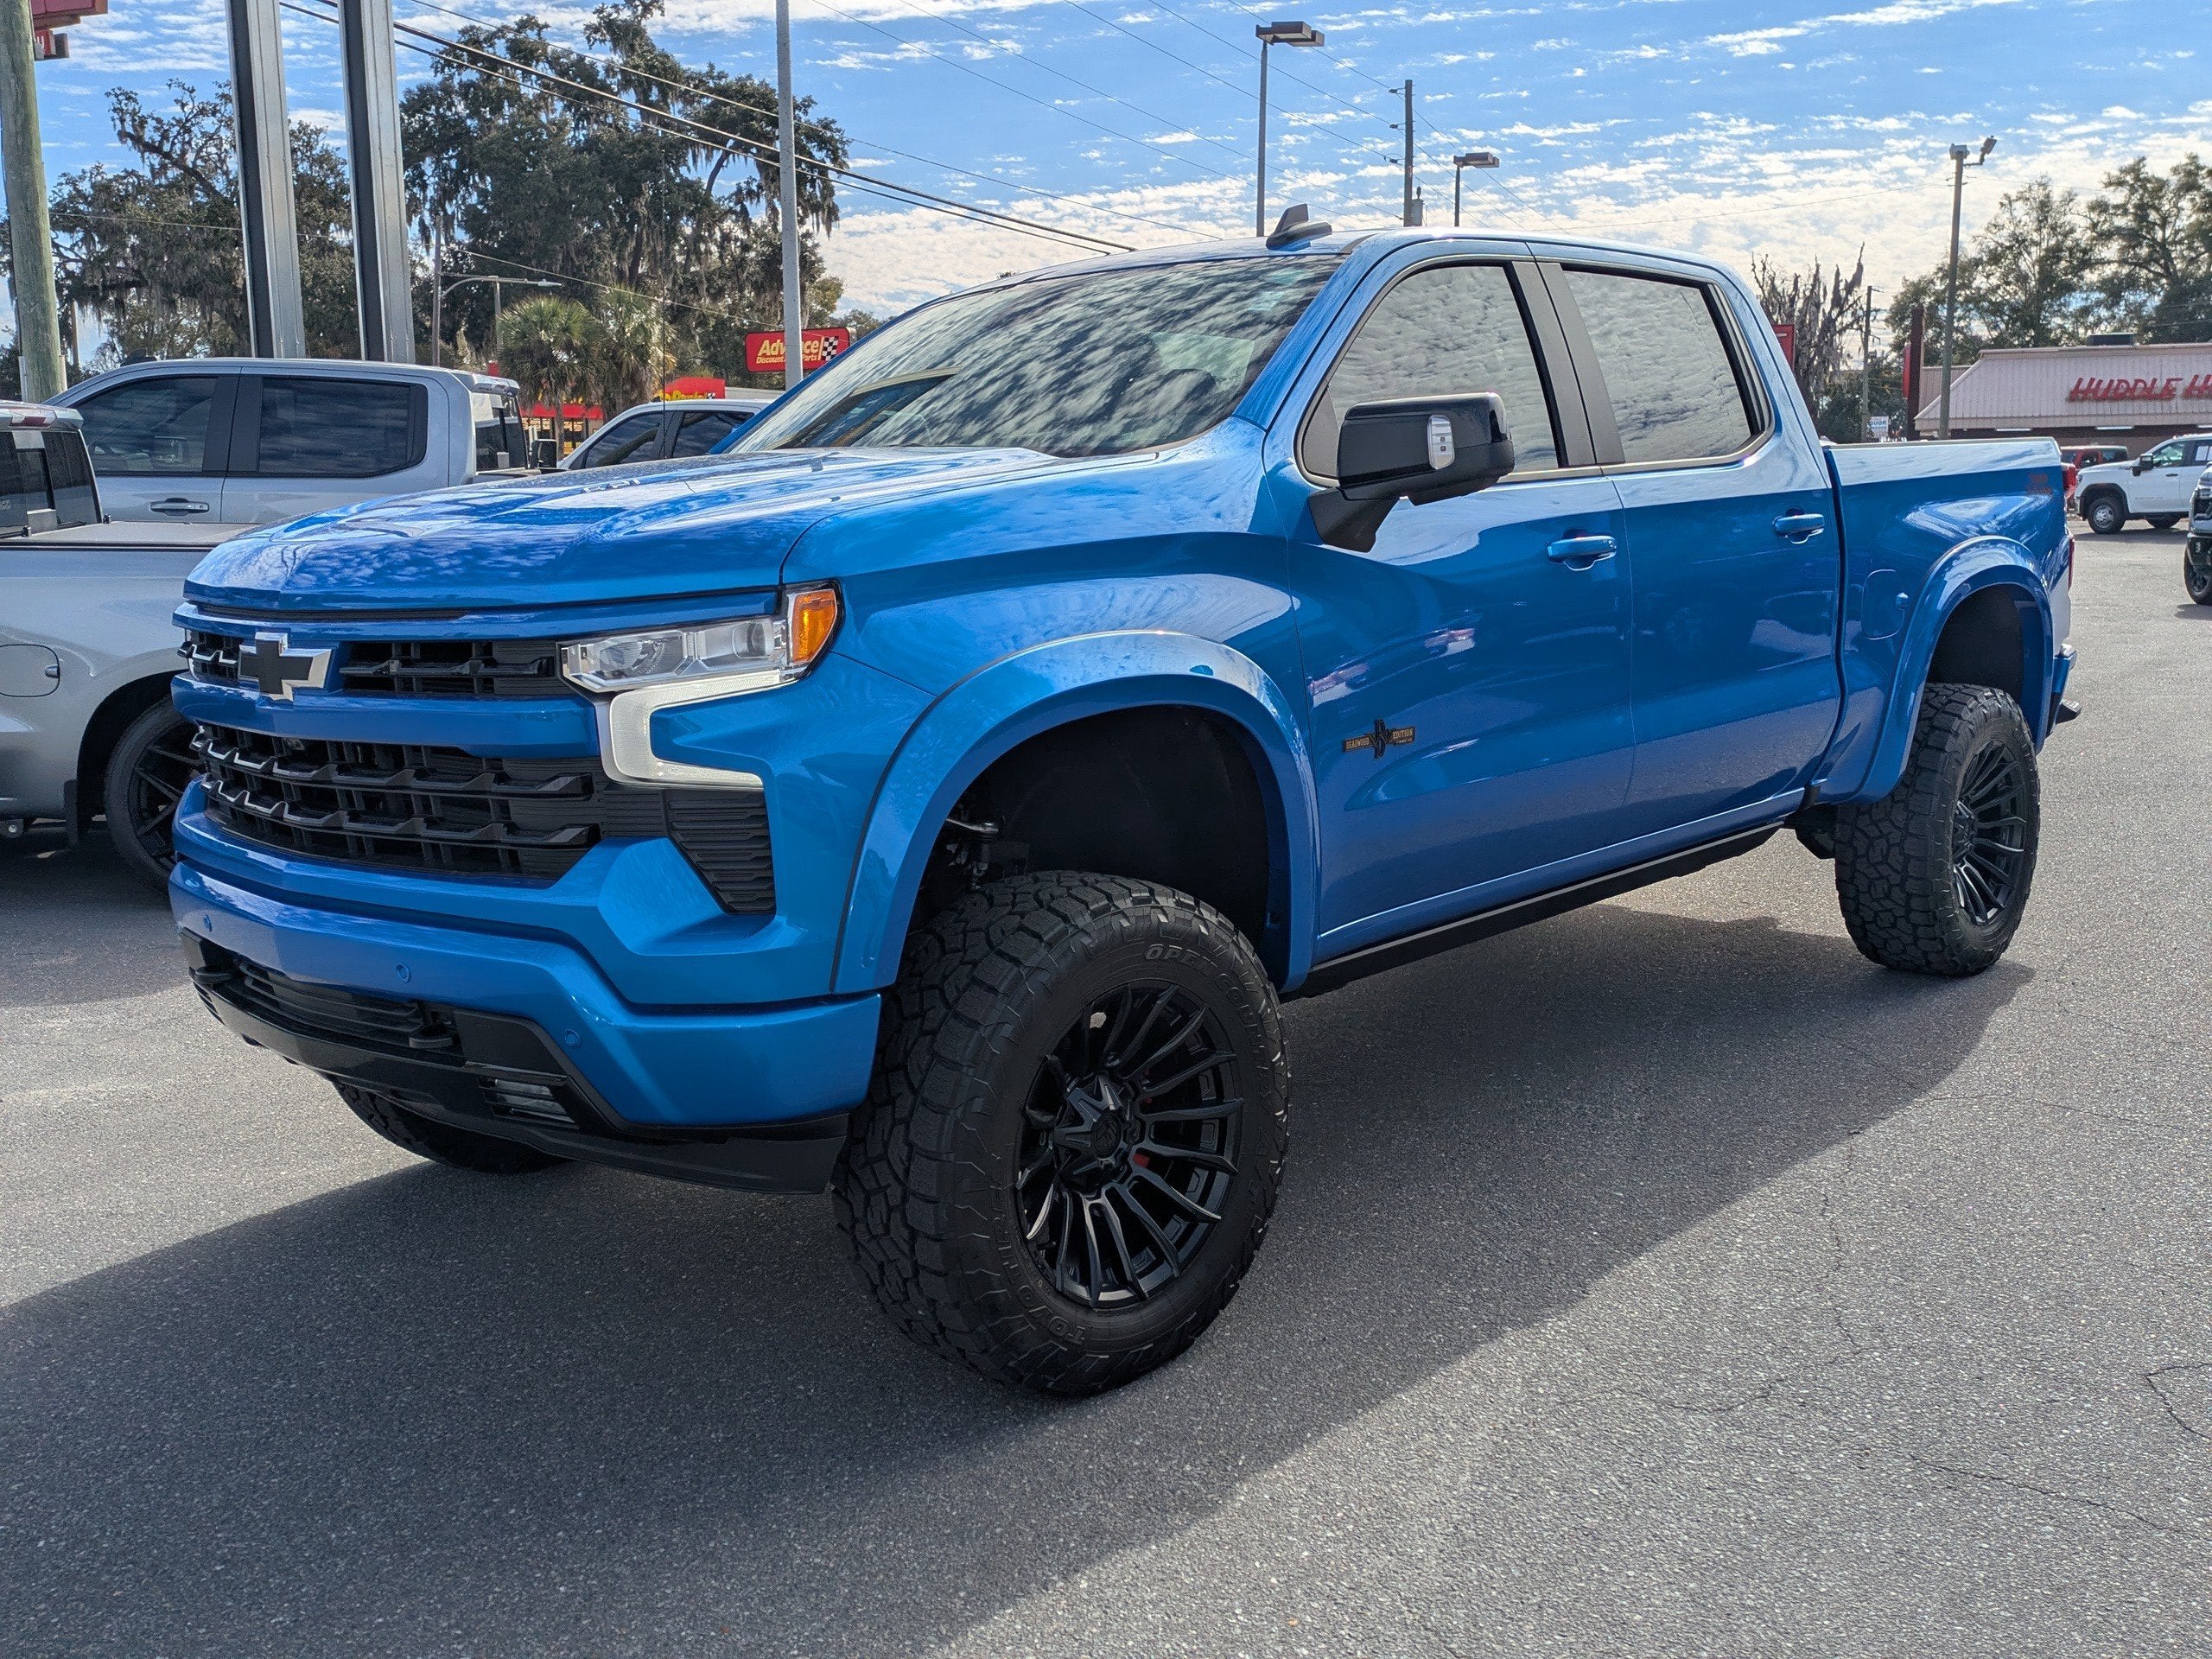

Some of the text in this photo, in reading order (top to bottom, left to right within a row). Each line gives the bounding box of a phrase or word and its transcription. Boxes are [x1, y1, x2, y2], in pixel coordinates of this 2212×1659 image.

[757, 339, 820, 356] Advce
[2069, 377, 2183, 401] HUDDLE
[1392, 728, 1414, 740] EDITION
[1145, 943, 1217, 976] OPEN
[1015, 1283, 1086, 1346] TOYO
